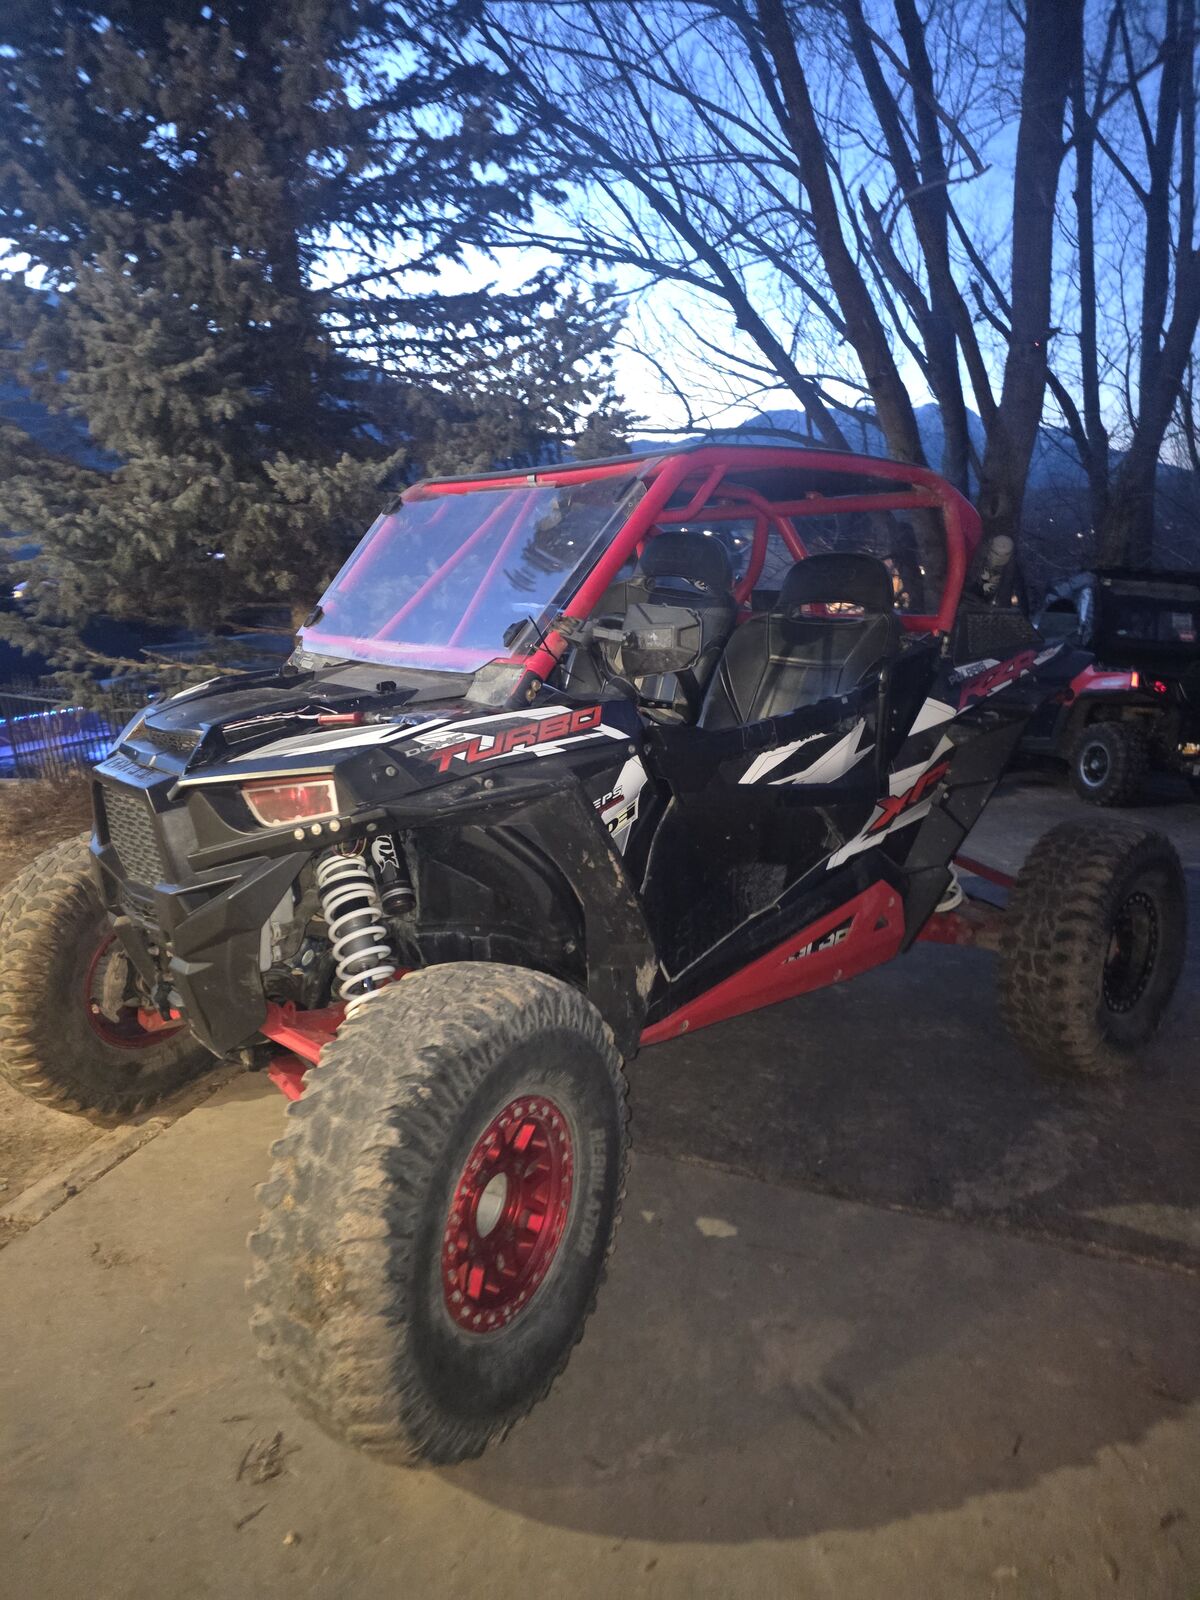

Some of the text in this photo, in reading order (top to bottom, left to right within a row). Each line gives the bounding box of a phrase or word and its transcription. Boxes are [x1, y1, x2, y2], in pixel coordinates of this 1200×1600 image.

[404, 733, 466, 757] DOHC
[427, 705, 603, 773] TURBO
[592, 785, 623, 808] EPS
